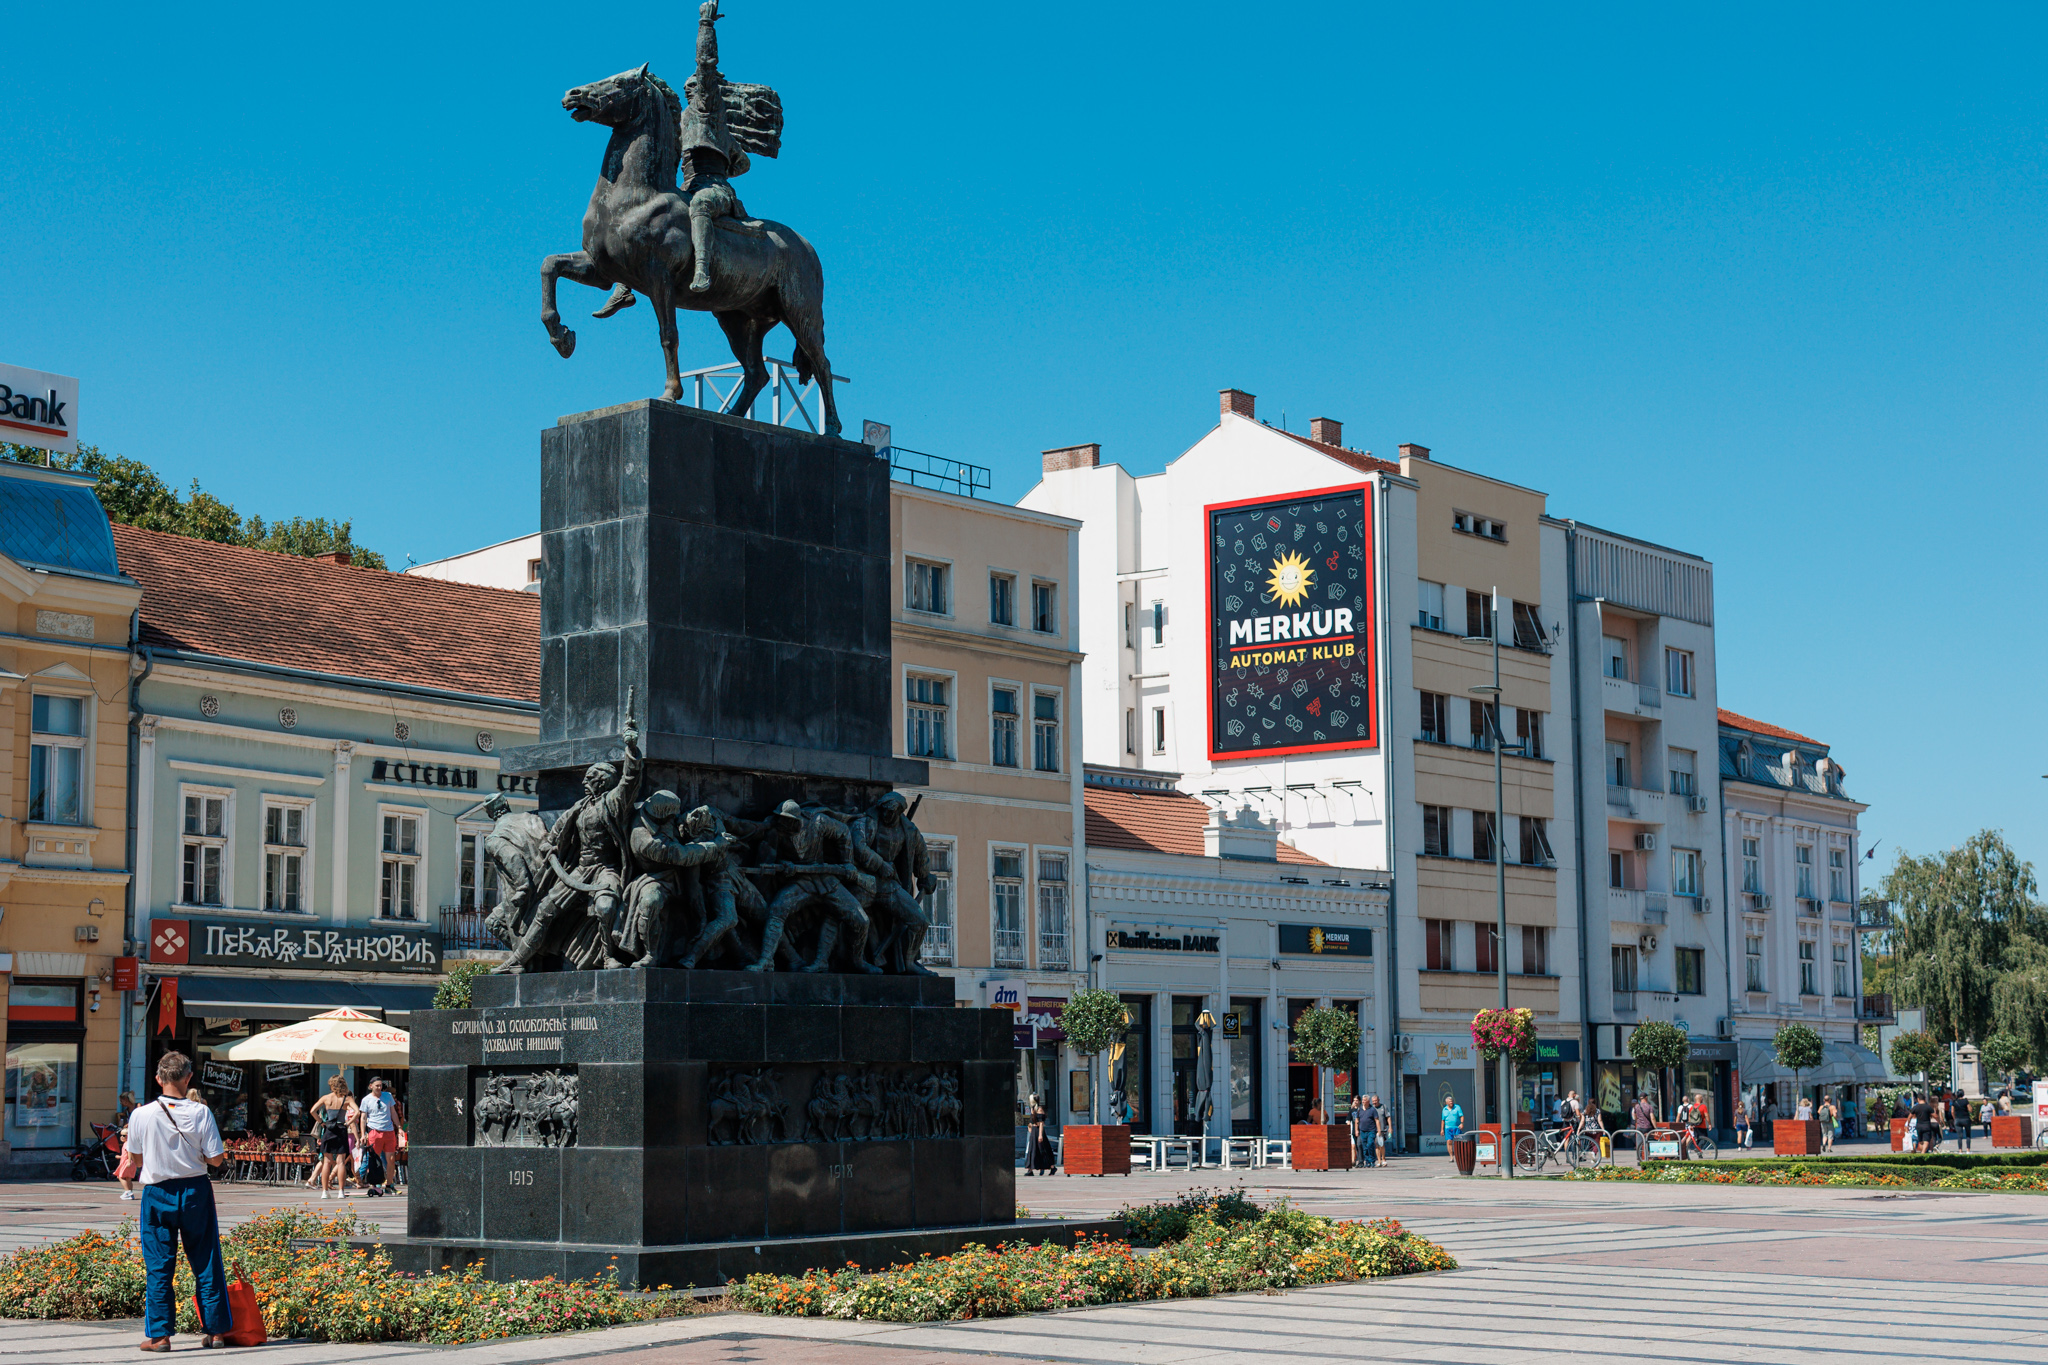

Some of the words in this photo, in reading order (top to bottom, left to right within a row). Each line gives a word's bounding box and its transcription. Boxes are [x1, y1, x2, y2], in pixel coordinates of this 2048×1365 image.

[1229, 607, 1354, 645] MERKUR
[1230, 648, 1307, 669] AUTOMAT
[1312, 643, 1355, 660] KLUB
[497, 775, 538, 795] СРЕ
[206, 925, 298, 963] ПЕКАРА
[303, 929, 436, 965] БРАНКОВИЋ
[1119, 931, 1182, 951] Raiffeisen
[1182, 935, 1220, 952] BANK
[1325, 933, 1350, 942] MERKUR
[995, 986, 1018, 1003] dm
[496, 1020, 507, 1034] ЗА
[571, 1016, 598, 1031] НИША
[509, 1170, 534, 1186] 1915
[829, 1163, 853, 1179] 1918
